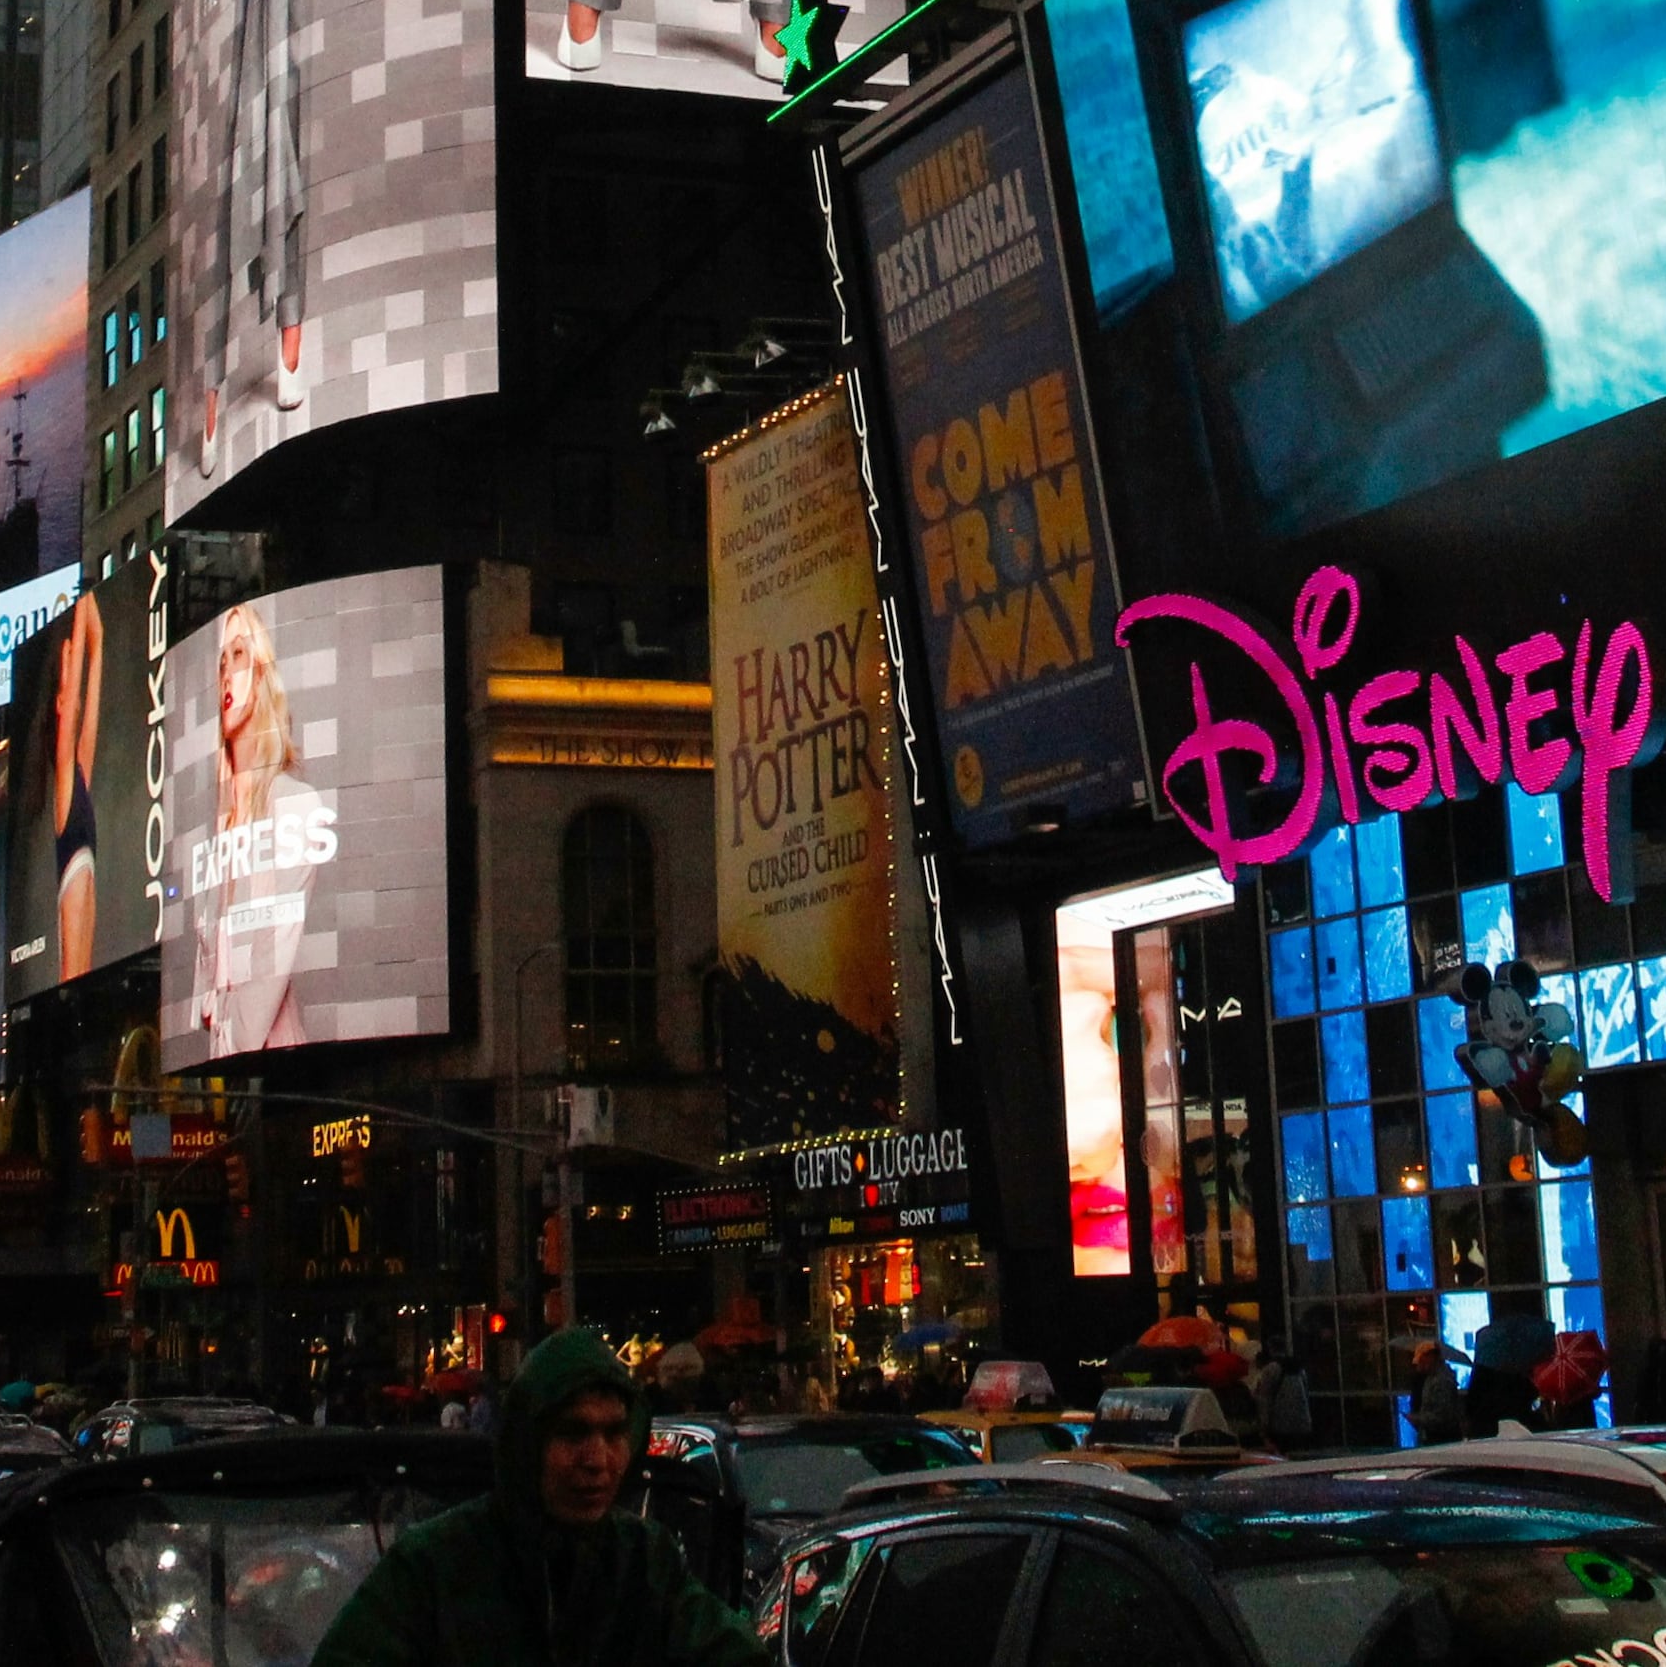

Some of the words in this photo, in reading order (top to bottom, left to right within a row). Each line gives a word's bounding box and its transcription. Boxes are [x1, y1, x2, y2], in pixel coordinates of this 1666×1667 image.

[877, 224, 931, 316] BEST
[931, 168, 1038, 282] MUSICAL
[908, 284, 952, 337] ACROSS
[990, 234, 1045, 291] AMERICA
[733, 445, 783, 483] WILDLY
[912, 370, 1075, 522] COME
[741, 483, 771, 515] AND
[775, 443, 846, 497] THRILLING
[720, 503, 793, 558] BROADWAY
[735, 555, 755, 580] THE
[756, 541, 790, 573] SHOW
[944, 558, 1095, 710] AWAY
[734, 608, 868, 745] HARRY
[146, 547, 169, 940] JOCKEY
[537, 734, 590, 763] THE
[599, 737, 683, 766] SHOW
[729, 707, 885, 848] POTTER
[191, 806, 338, 896] EXPRESS
[747, 846, 810, 894] CURSED
[814, 830, 870, 875] CHILD
[782, 823, 805, 847] AND
[806, 816, 826, 842] THE
[763, 896, 787, 918] PARTS
[789, 892, 807, 911] ONE
[808, 887, 829, 906] AND
[830, 880, 852, 899] TWO
[111, 1128, 228, 1150] Mnald's
[794, 1143, 853, 1191] GIFTS
[868, 1127, 968, 1181] LUGGAGE
[716, 1220, 767, 1242] LUGGAGE
[899, 1206, 936, 1228] SONY
